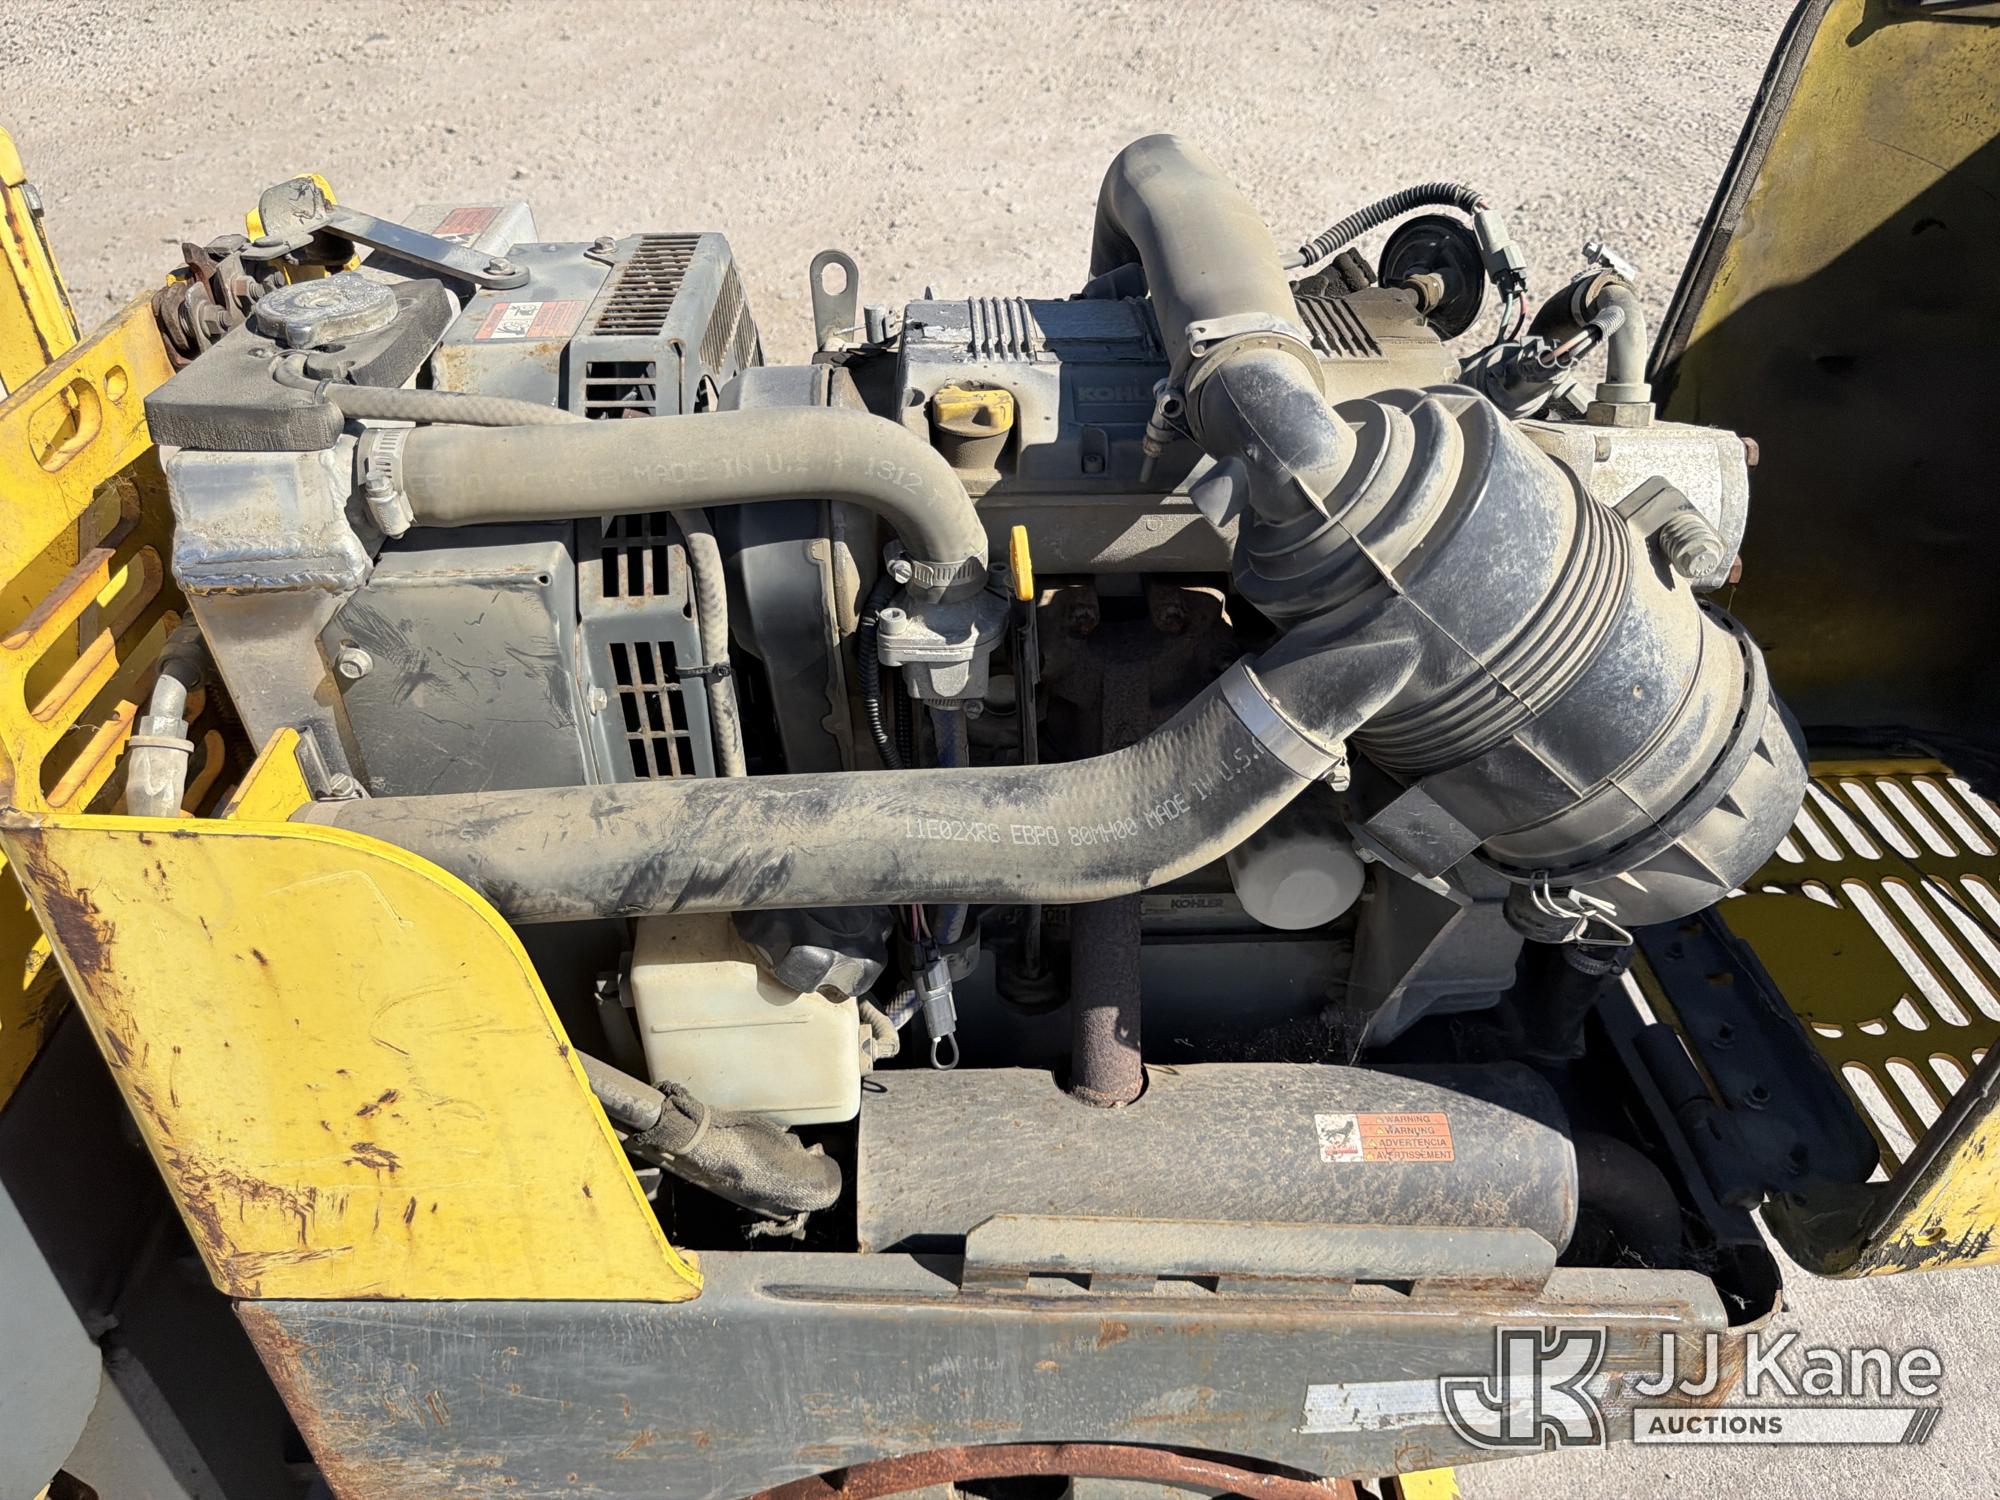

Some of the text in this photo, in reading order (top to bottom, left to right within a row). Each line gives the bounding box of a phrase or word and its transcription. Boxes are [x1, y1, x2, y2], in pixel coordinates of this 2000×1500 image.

[1143, 792, 1191, 830] MADE
[1191, 773, 1216, 801] IN
[1170, 898, 1224, 909] KOHLER
[1384, 1115, 1431, 1123] WARNING
[1384, 1125, 1436, 1134] WARNUNG
[1379, 1138, 1447, 1147] ADVERTENCIA
[1376, 1150, 1452, 1159] AVERTISSEMENT
